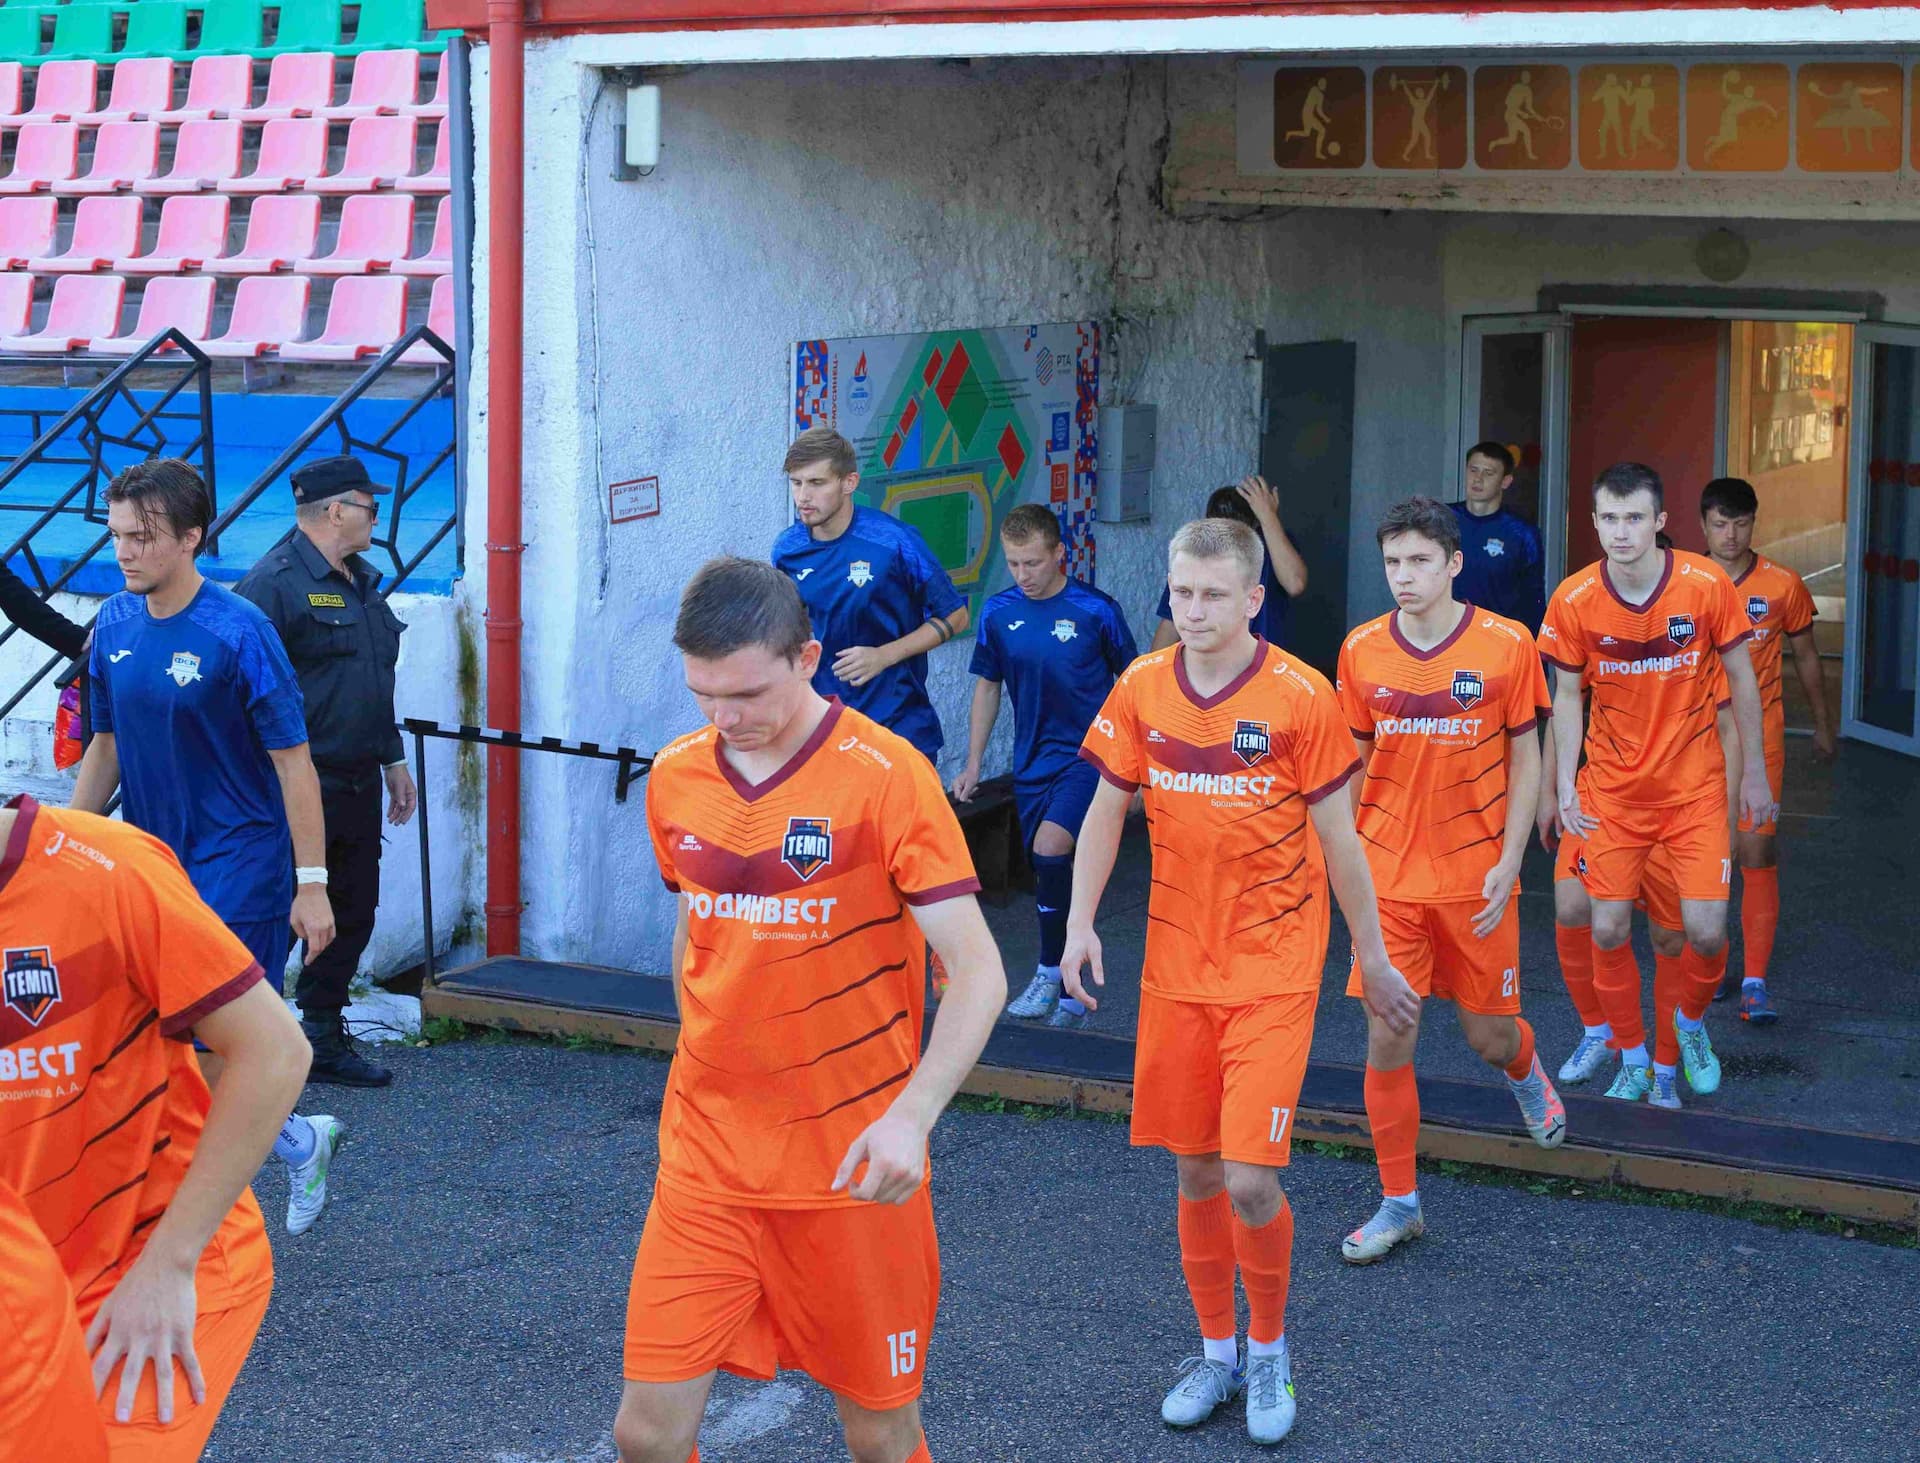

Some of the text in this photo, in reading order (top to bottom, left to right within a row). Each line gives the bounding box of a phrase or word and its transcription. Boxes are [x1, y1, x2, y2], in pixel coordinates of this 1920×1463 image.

[1750, 602, 1767, 613] ТЕМП
[1670, 623, 1693, 637] ТЕМП
[1599, 651, 1701, 676] ПРОДИНВЕСТ
[1455, 681, 1480, 696] ТЕМП
[1236, 733, 1267, 751] ТЕМП
[787, 834, 828, 858] ТЕМП
[682, 891, 837, 924] РОДИНВЕСТ
[752, 929, 807, 942] Бродников
[7, 969, 54, 998] ТЕМП
[1502, 967, 1519, 997] 21
[1269, 1106, 1290, 1143] 17
[887, 1329, 916, 1378] 15
